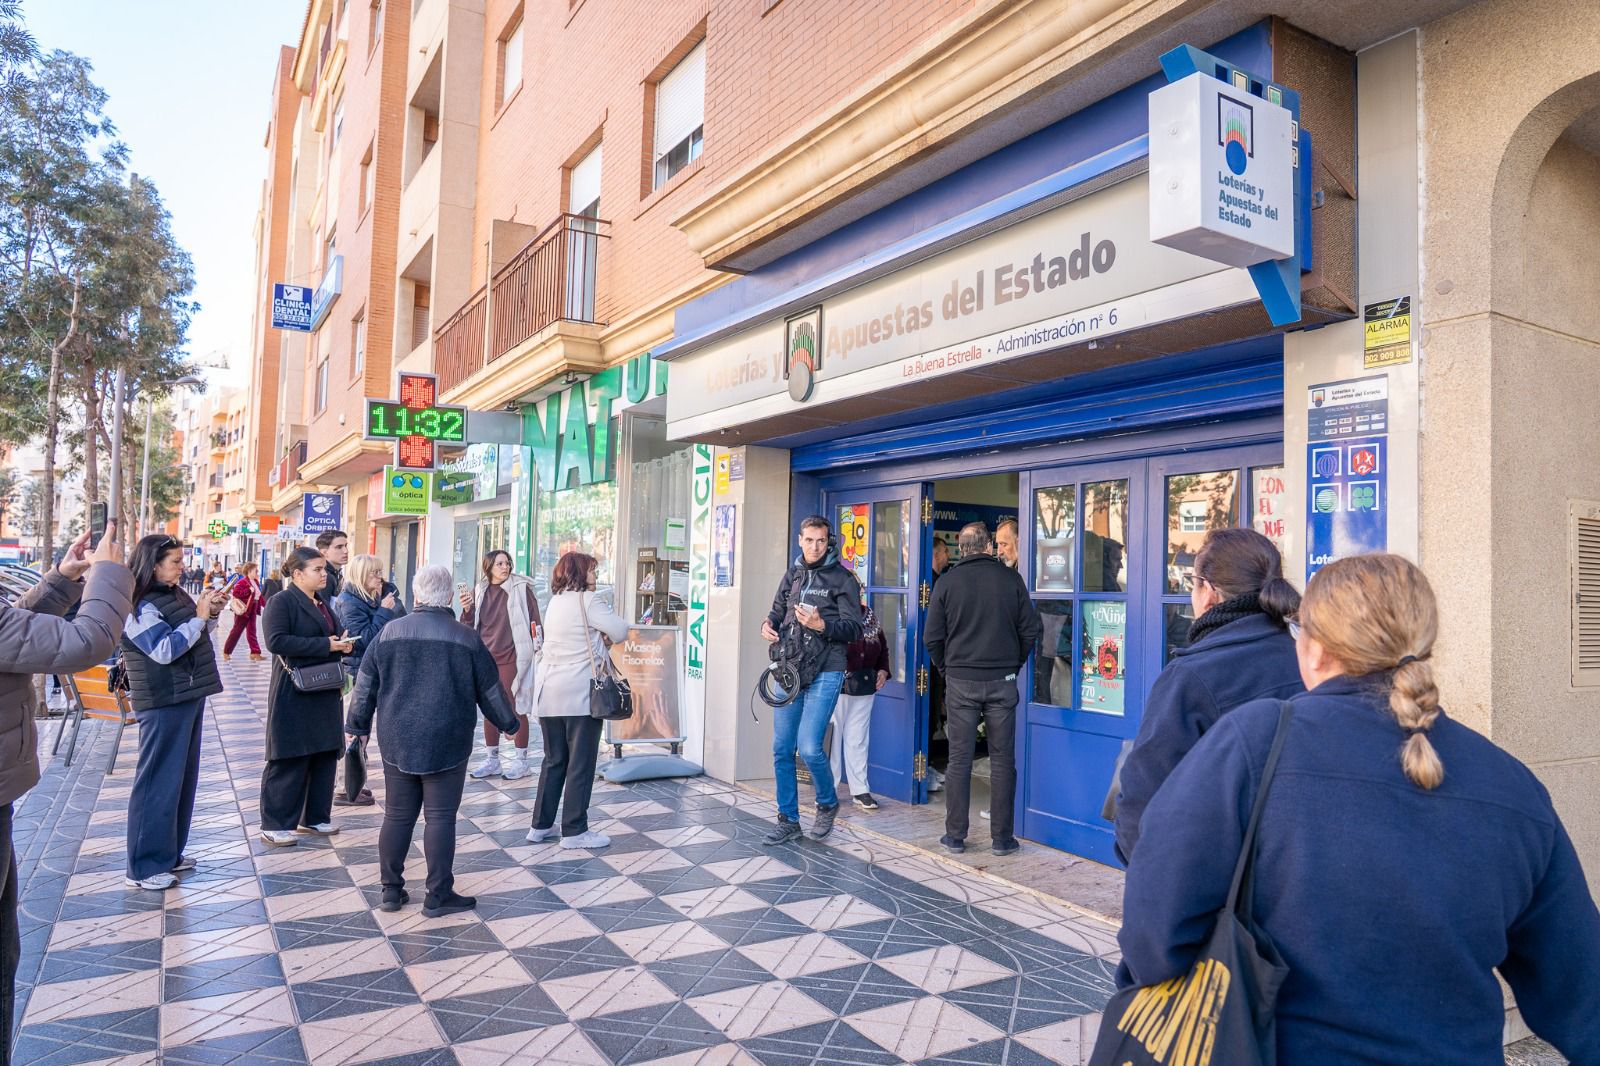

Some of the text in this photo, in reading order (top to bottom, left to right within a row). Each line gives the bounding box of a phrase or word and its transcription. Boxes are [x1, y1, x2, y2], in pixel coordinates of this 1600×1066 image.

[1218, 170, 1265, 202] Loterías y
[1218, 189, 1279, 221] Apuestas del
[1218, 206, 1252, 229] Estado
[274, 298, 311, 311] CLINICA
[274, 305, 310, 318] DENTAL
[705, 231, 1117, 395] Loterías y Apuestas del Estado
[1366, 318, 1409, 334] ALARMA
[902, 362, 914, 378] La
[915, 356, 945, 376] Buena
[946, 345, 983, 367] Estrella
[996, 318, 1087, 355] Administración
[1108, 308, 1119, 326] 6
[372, 406, 463, 439] 11:32
[687, 442, 711, 669] FARMACIA
[1309, 553, 1334, 565] Lote
[624, 640, 662, 655] Masaje
